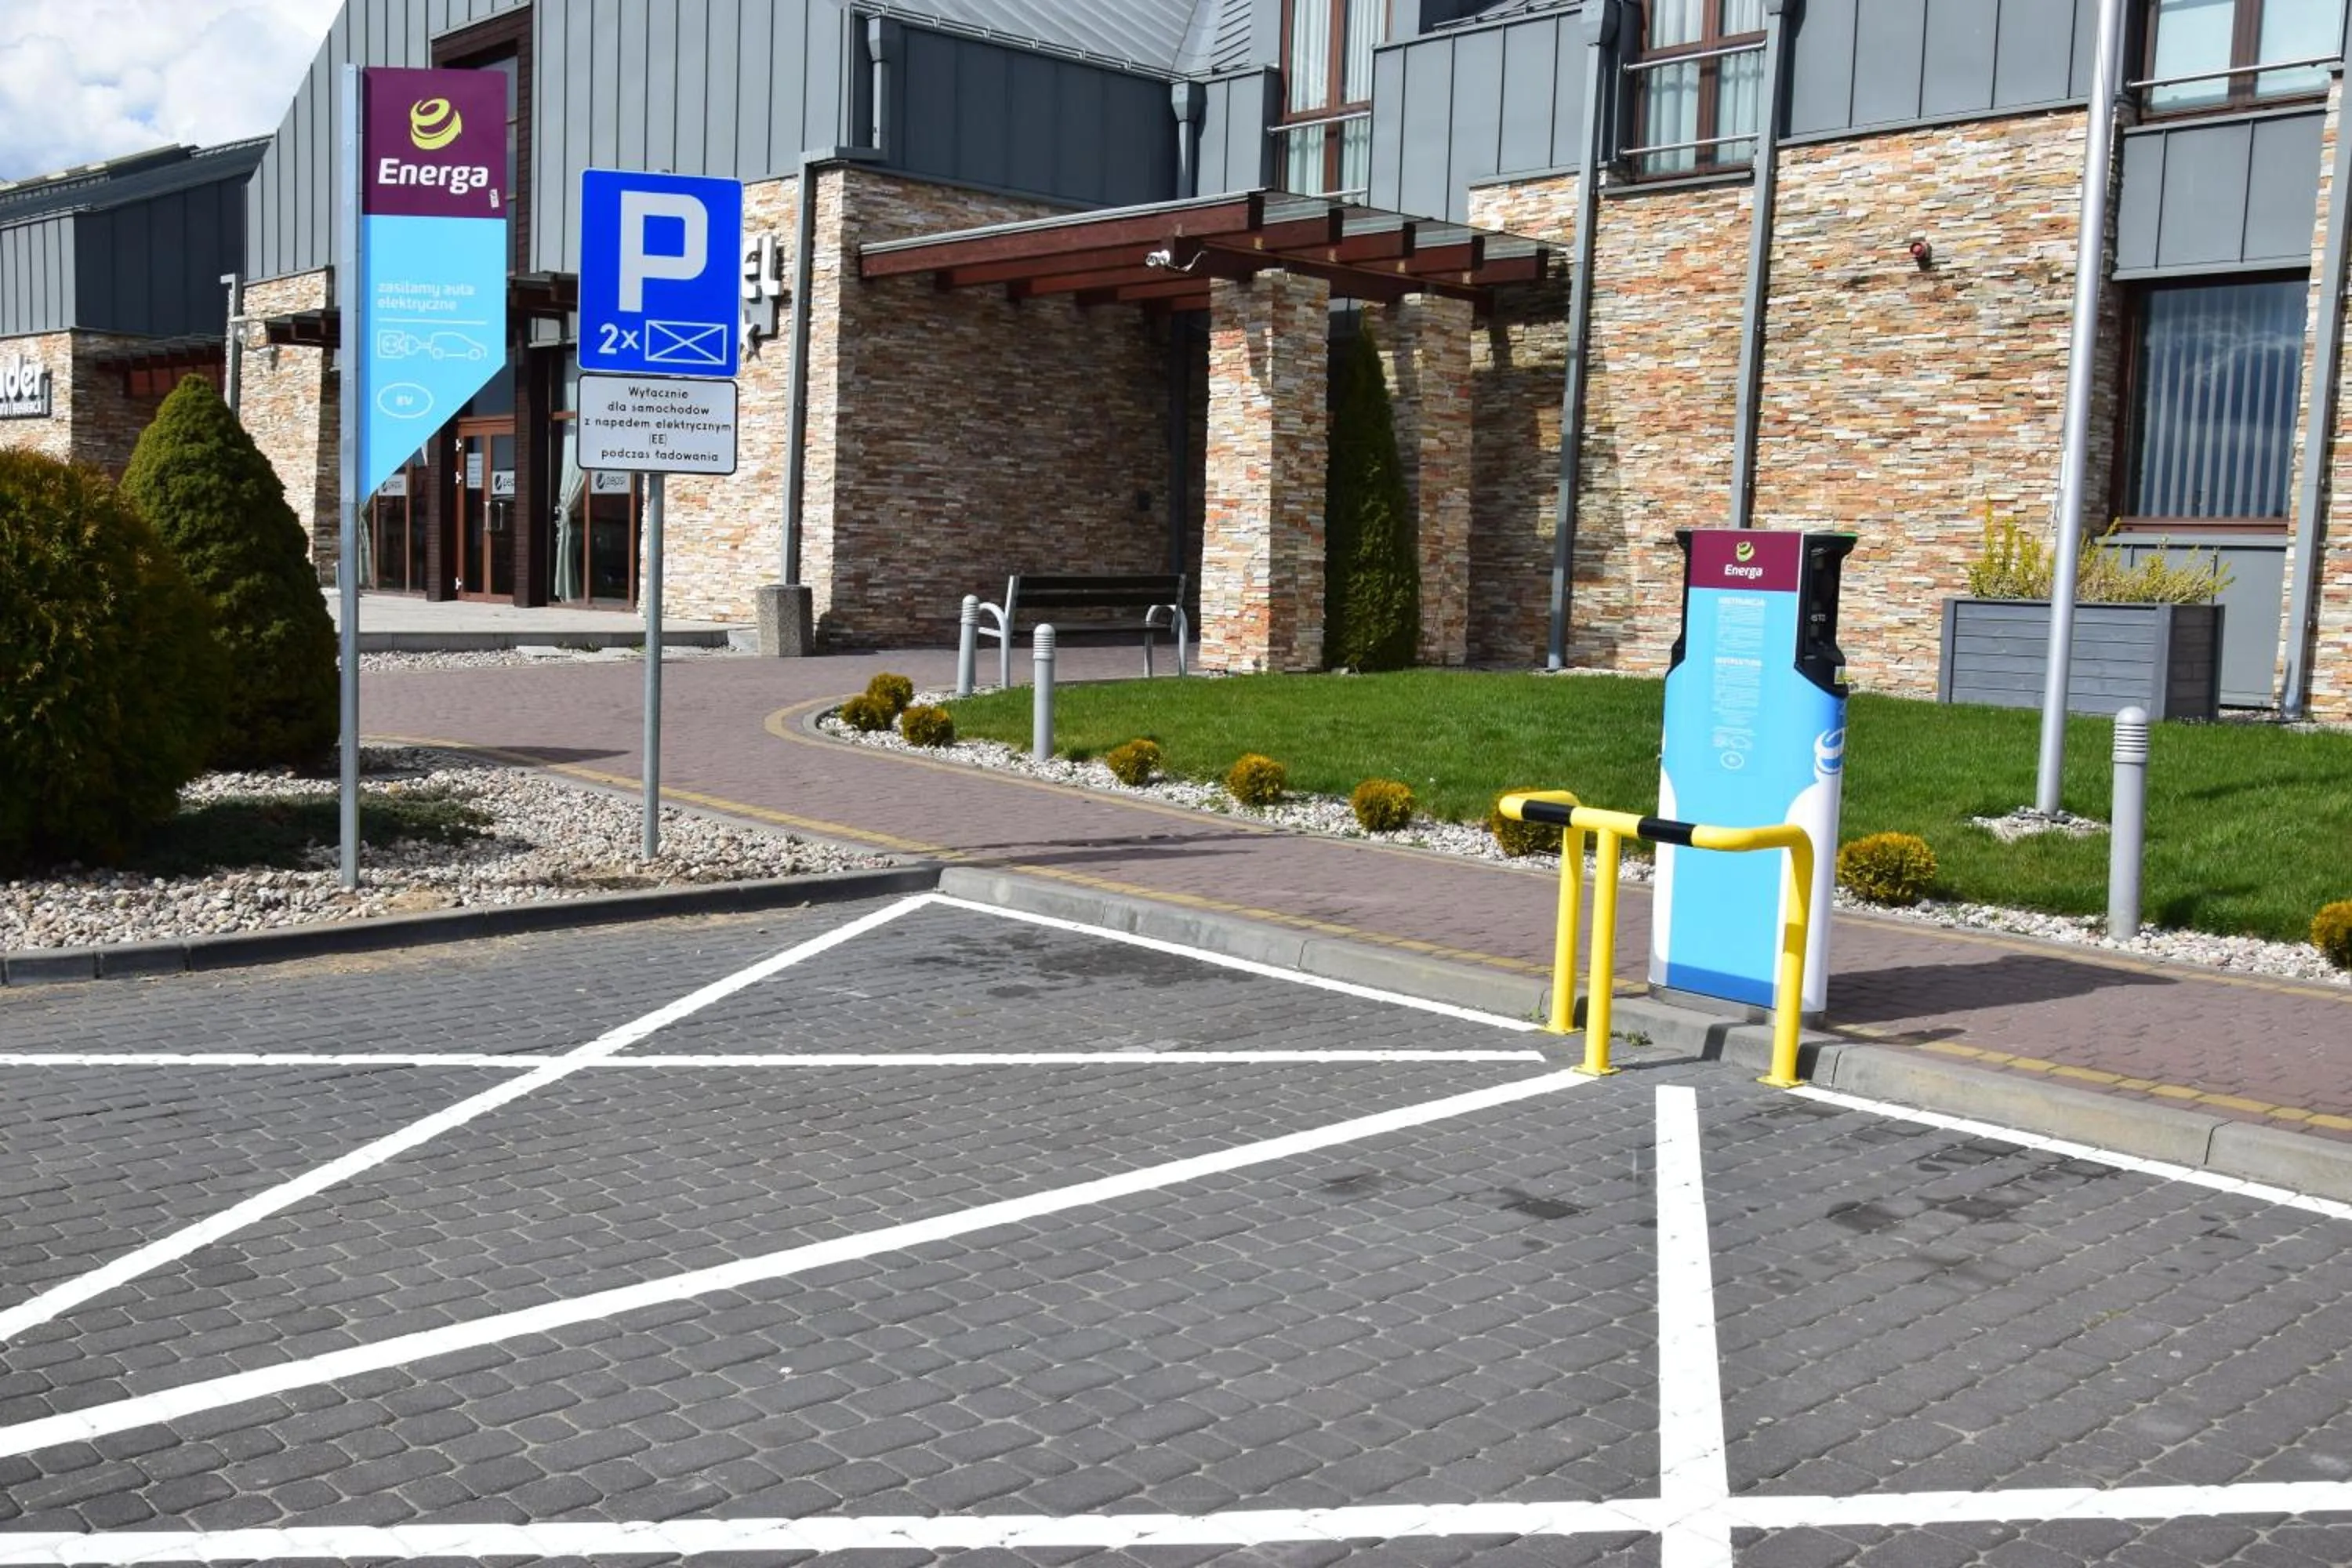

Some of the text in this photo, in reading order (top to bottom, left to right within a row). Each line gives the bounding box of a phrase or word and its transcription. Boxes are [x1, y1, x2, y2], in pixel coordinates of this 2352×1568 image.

[378, 158, 488, 194] Energa
[619, 191, 708, 313] P
[442, 282, 477, 296] auta
[377, 296, 458, 313] elektryczne
[607, 401, 627, 412] dla
[655, 419, 731, 434] elektrycznym
[601, 448, 650, 460] podczas
[1724, 564, 1763, 579] Energa
